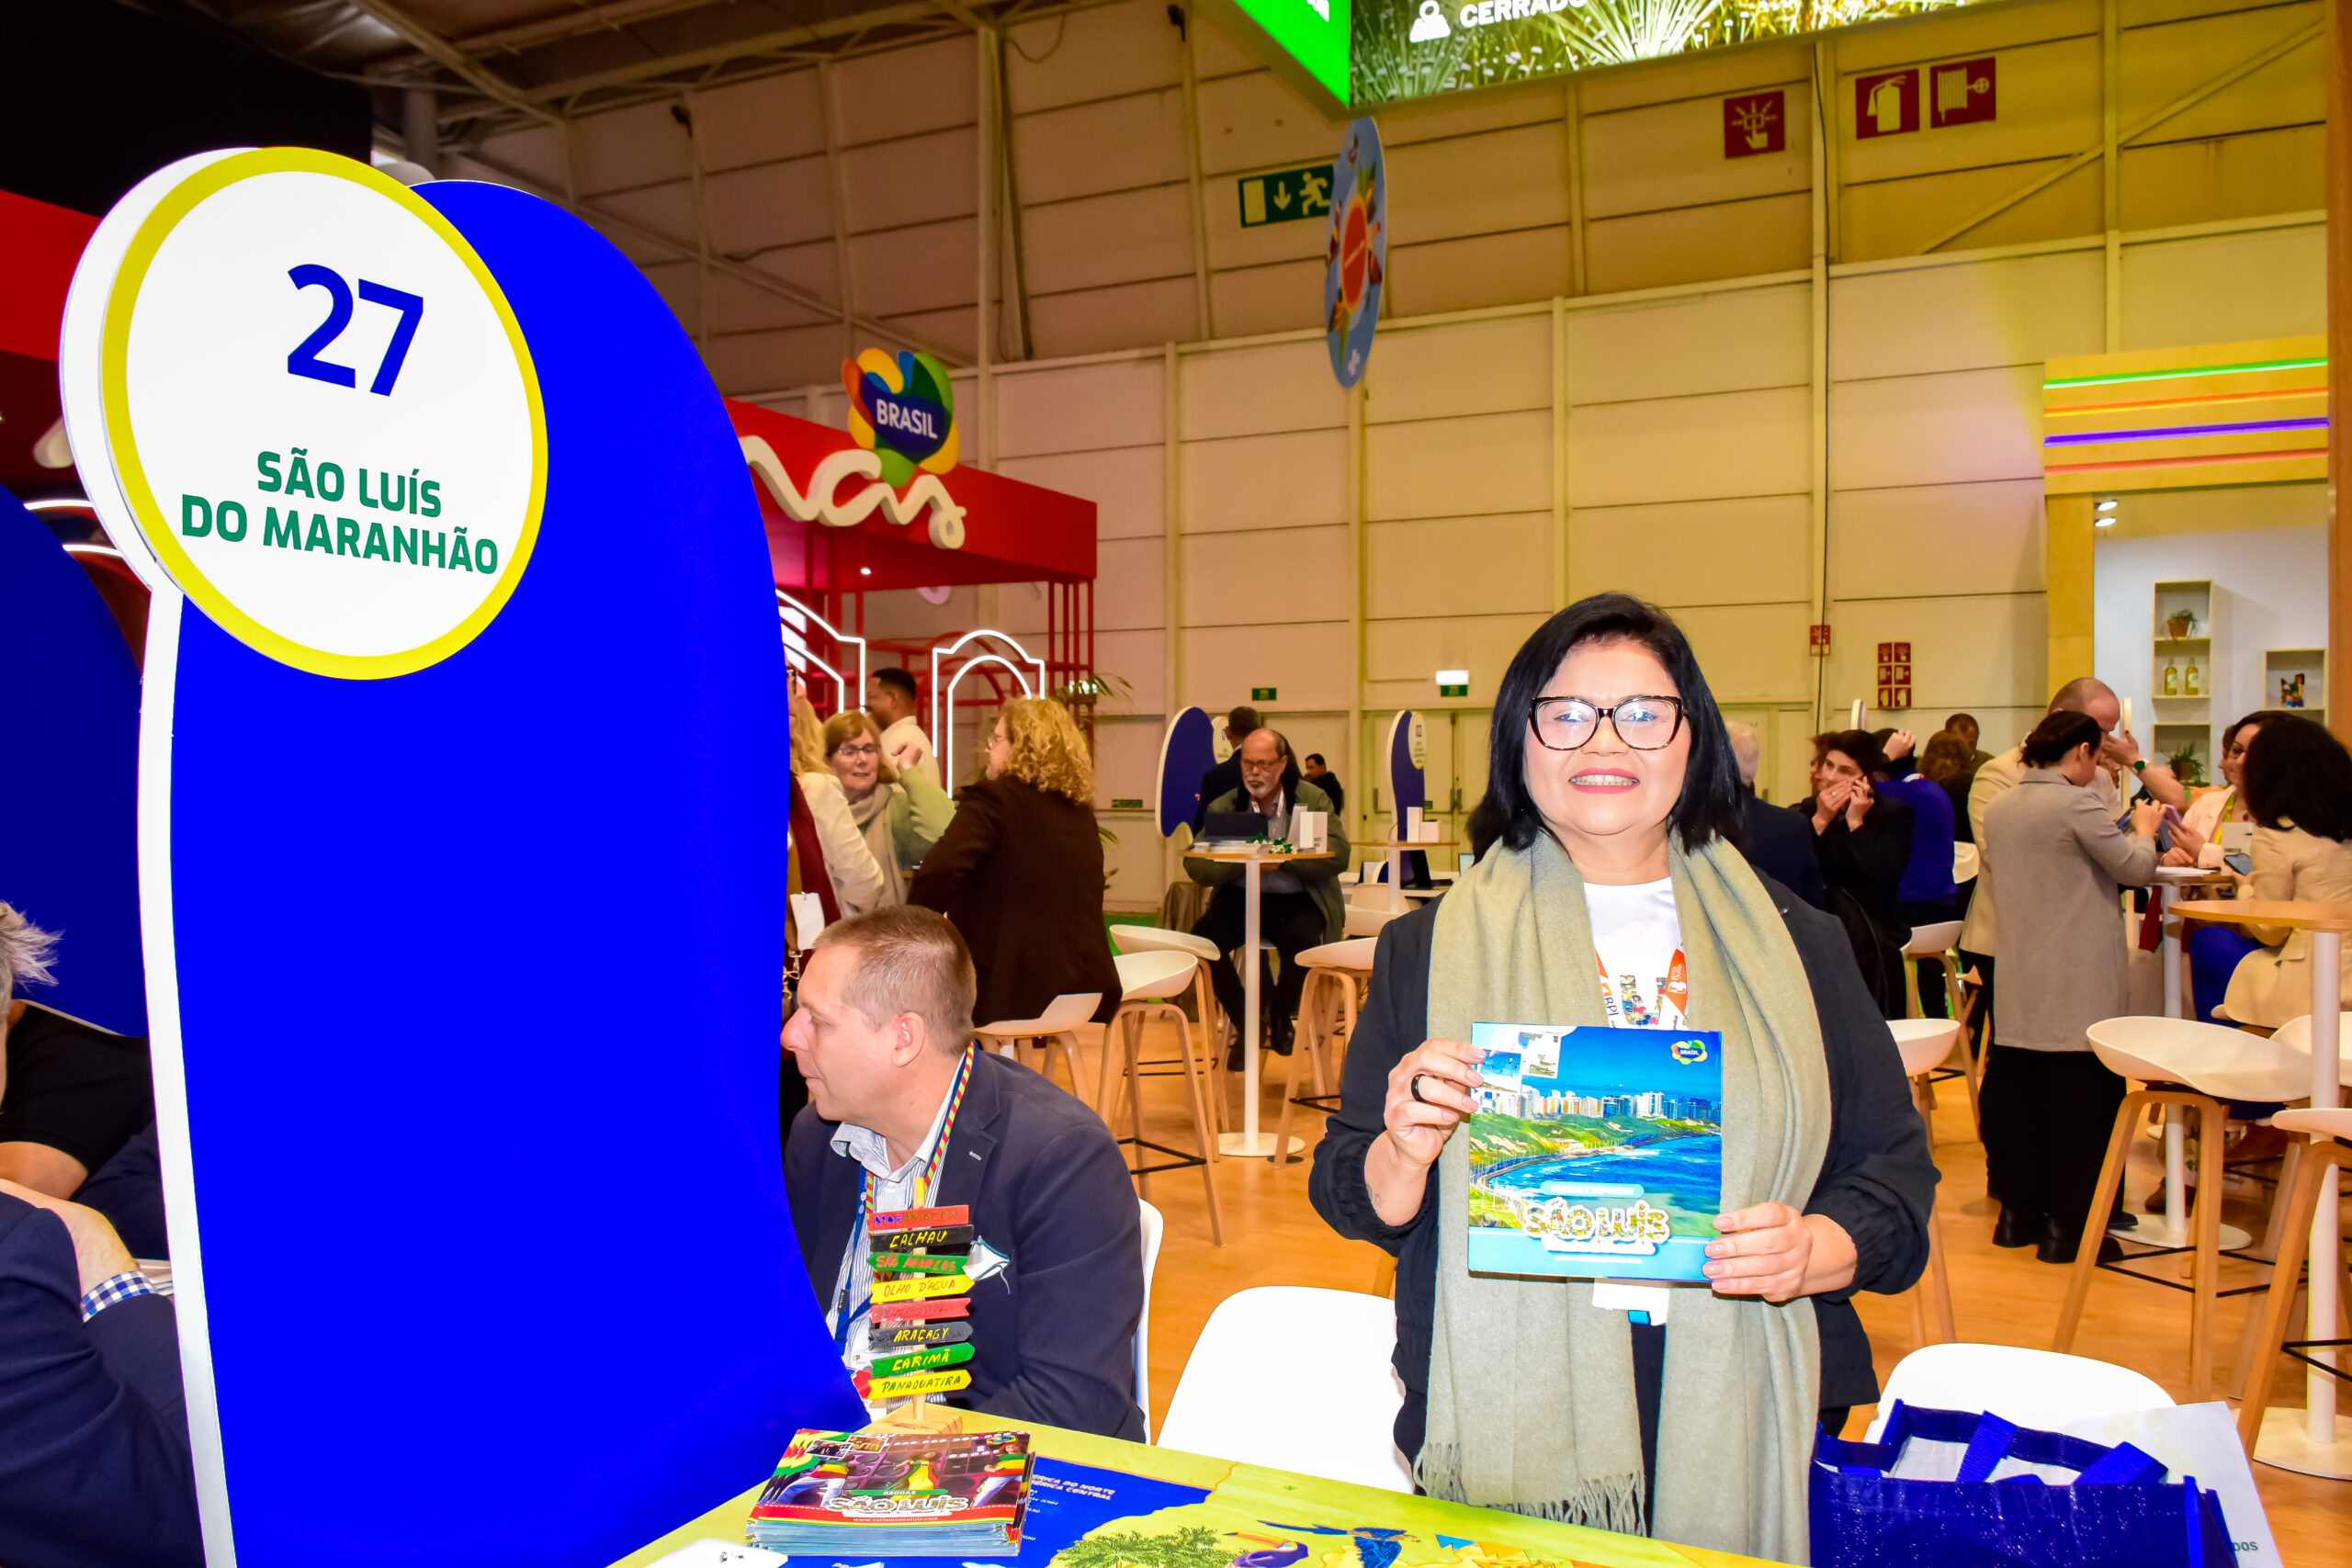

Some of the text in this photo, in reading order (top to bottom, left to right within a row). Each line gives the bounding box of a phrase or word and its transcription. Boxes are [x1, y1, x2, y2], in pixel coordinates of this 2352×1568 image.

[287, 263, 424, 397] 27
[875, 397, 938, 440] BRASIL
[256, 446, 442, 519] SÃO LUÍS
[181, 493, 499, 575] DO MARANHÃO
[889, 1230, 947, 1248] CALHAU
[903, 1258, 956, 1271] MARCOS
[884, 1284, 910, 1298] OLHO
[893, 1327, 949, 1343] ARAÇAGY
[1080, 1483, 1115, 1495] NORTE
